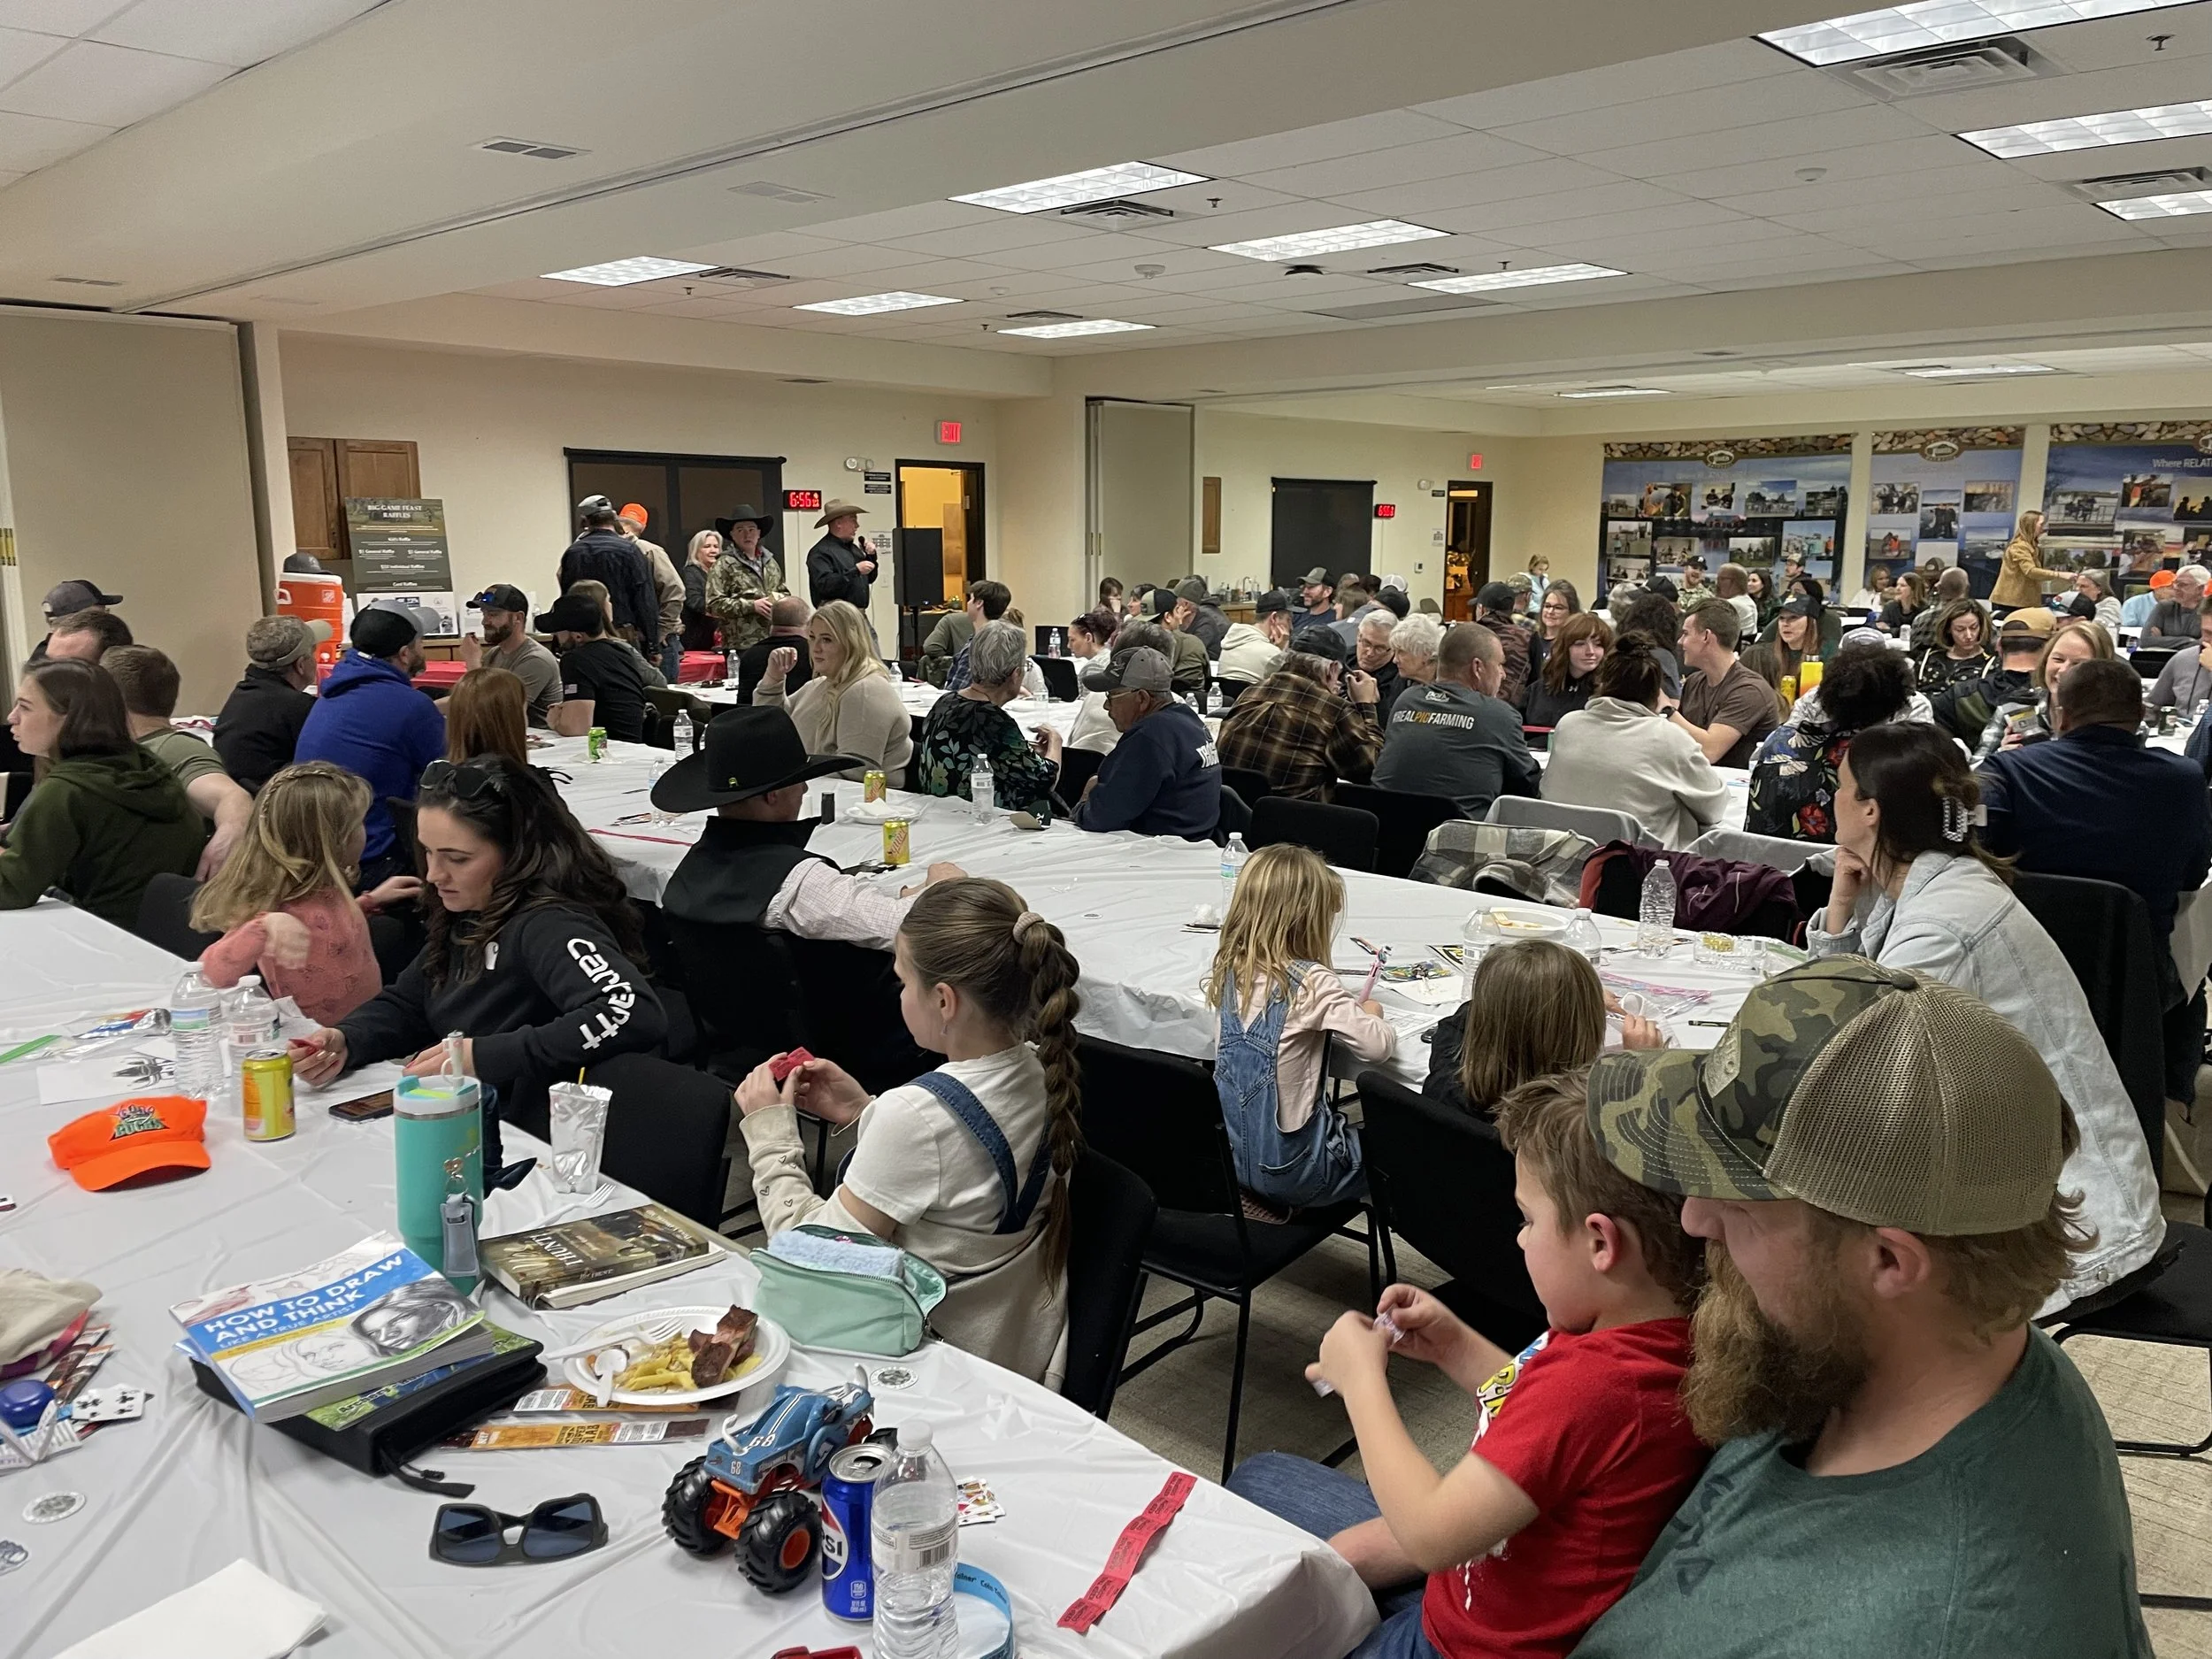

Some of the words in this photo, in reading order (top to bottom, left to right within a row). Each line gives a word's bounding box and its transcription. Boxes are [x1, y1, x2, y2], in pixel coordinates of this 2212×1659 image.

[941, 422, 961, 442] EXIT
[2152, 458, 2182, 467] Where
[789, 491, 811, 507] 6:56
[204, 1306, 275, 1333] HOW
[280, 1295, 319, 1311] TO
[325, 1256, 403, 1297] DRAW
[216, 1318, 279, 1343] AND
[282, 1289, 365, 1322] THINK
[219, 1335, 251, 1349] LIKE
[270, 1321, 304, 1334] TRUE
[311, 1303, 357, 1324] ARTIST
[749, 1433, 776, 1448] 68
[730, 1461, 741, 1475] 68
